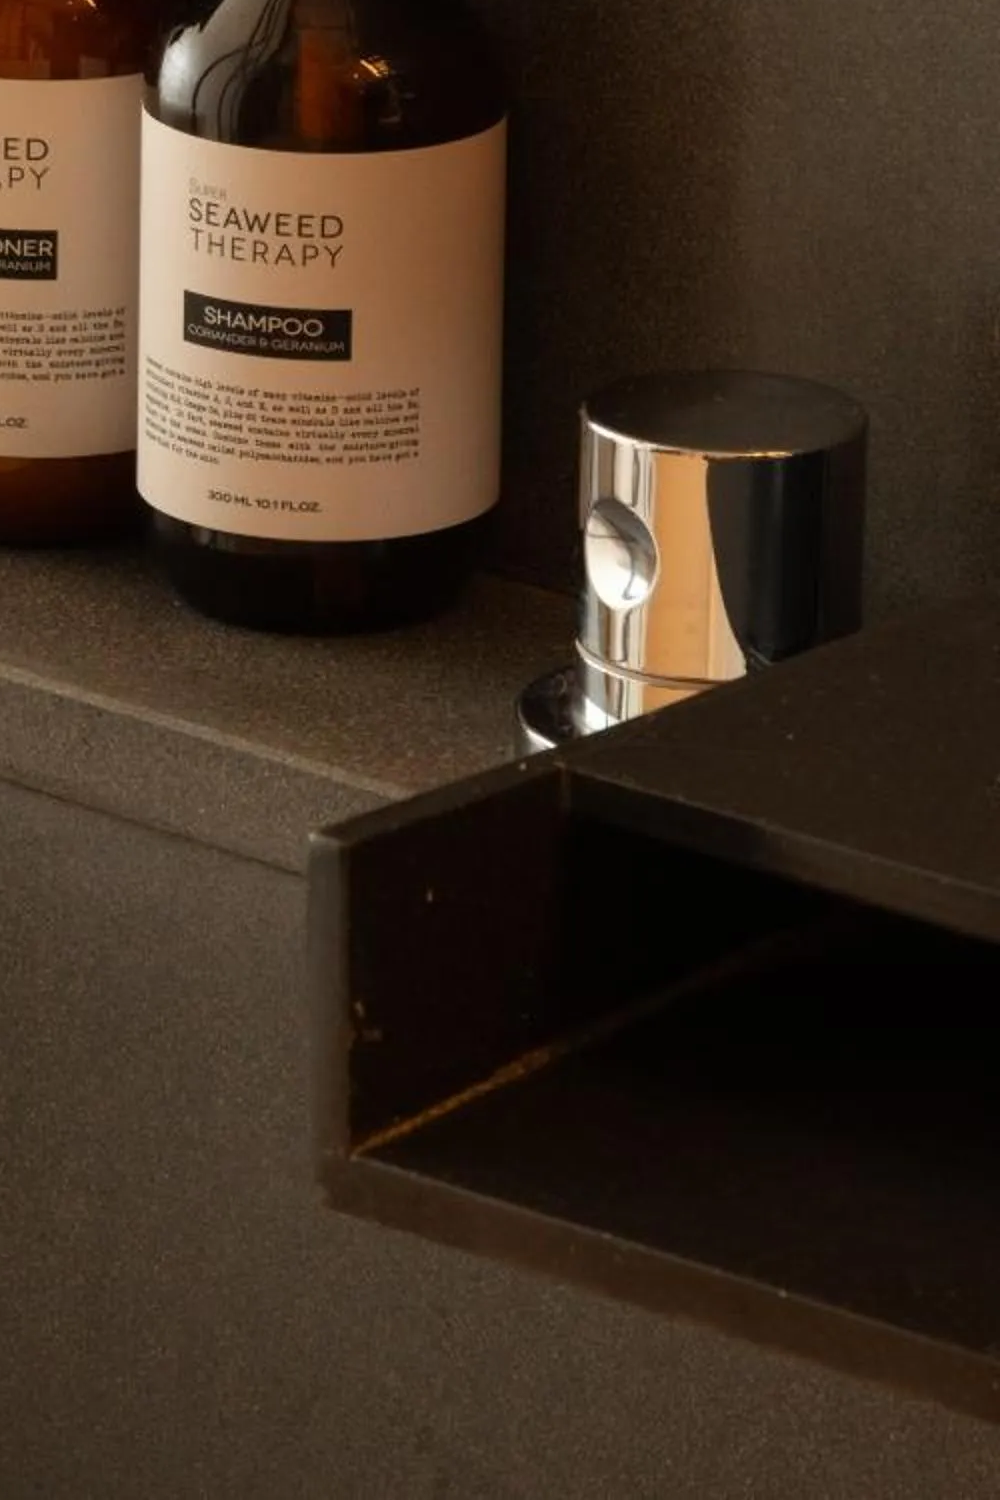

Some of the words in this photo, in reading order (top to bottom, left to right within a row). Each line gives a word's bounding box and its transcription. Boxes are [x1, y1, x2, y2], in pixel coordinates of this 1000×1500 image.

[189, 198, 344, 238] SEAWEED
[190, 228, 344, 268] THERAPY
[204, 306, 324, 337] SHAMPOO
[188, 324, 256, 346] CORIANDER
[272, 339, 345, 352] GERANIUM
[208, 490, 232, 504] 300
[234, 496, 253, 506] ML
